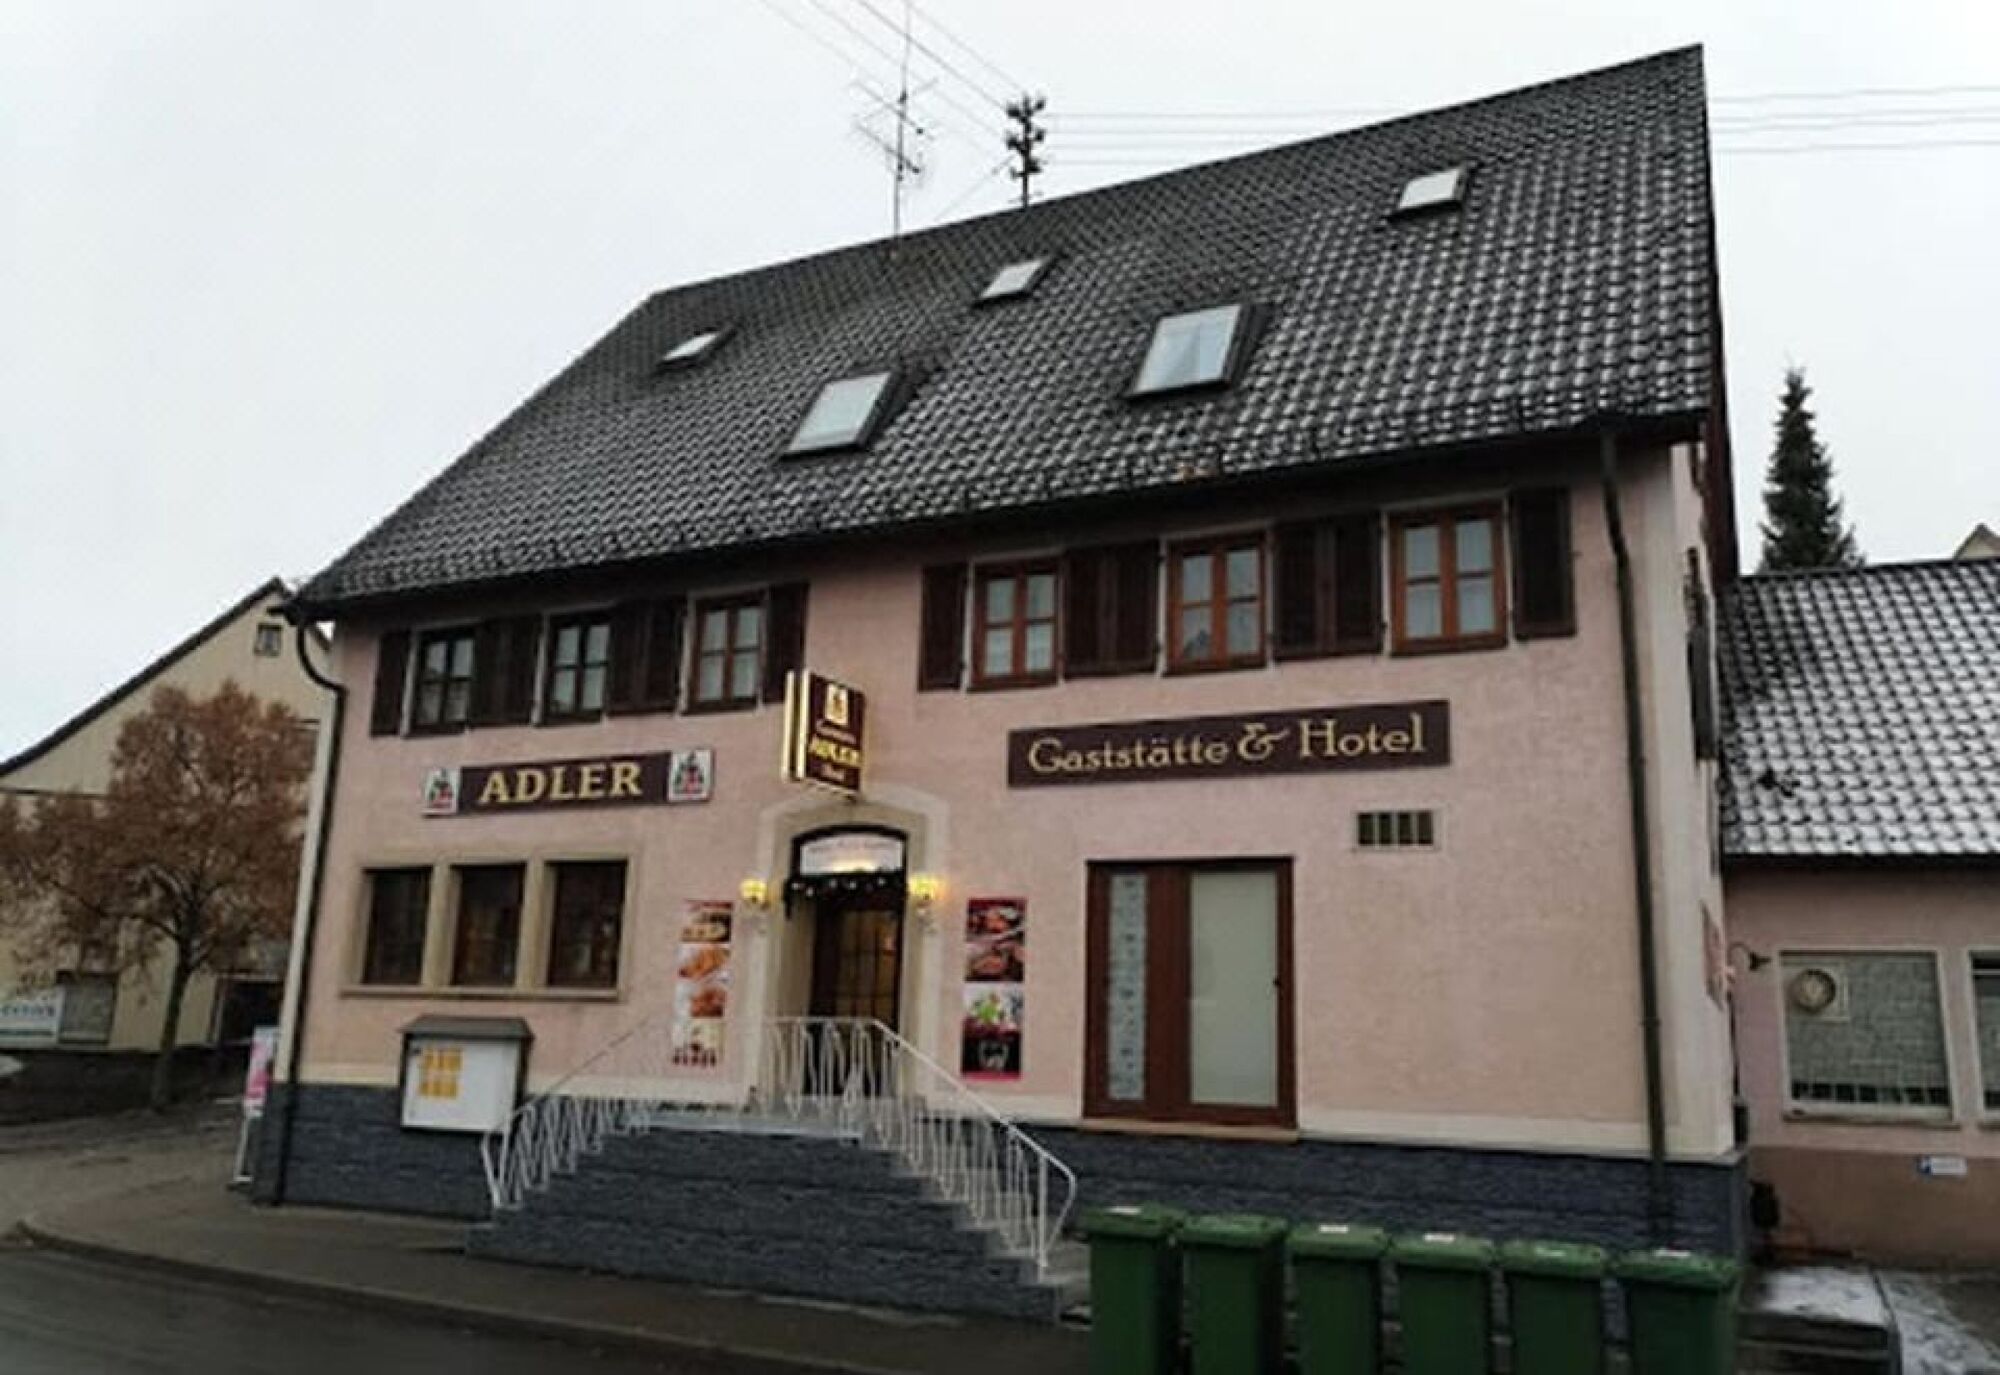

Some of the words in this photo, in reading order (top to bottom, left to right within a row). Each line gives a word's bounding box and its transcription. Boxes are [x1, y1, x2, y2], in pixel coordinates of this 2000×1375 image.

[1027, 736, 1229, 773] Gaststätte
[1236, 722, 1290, 761] &
[1299, 712, 1427, 758] Hotel
[478, 761, 645, 805] ADLER
